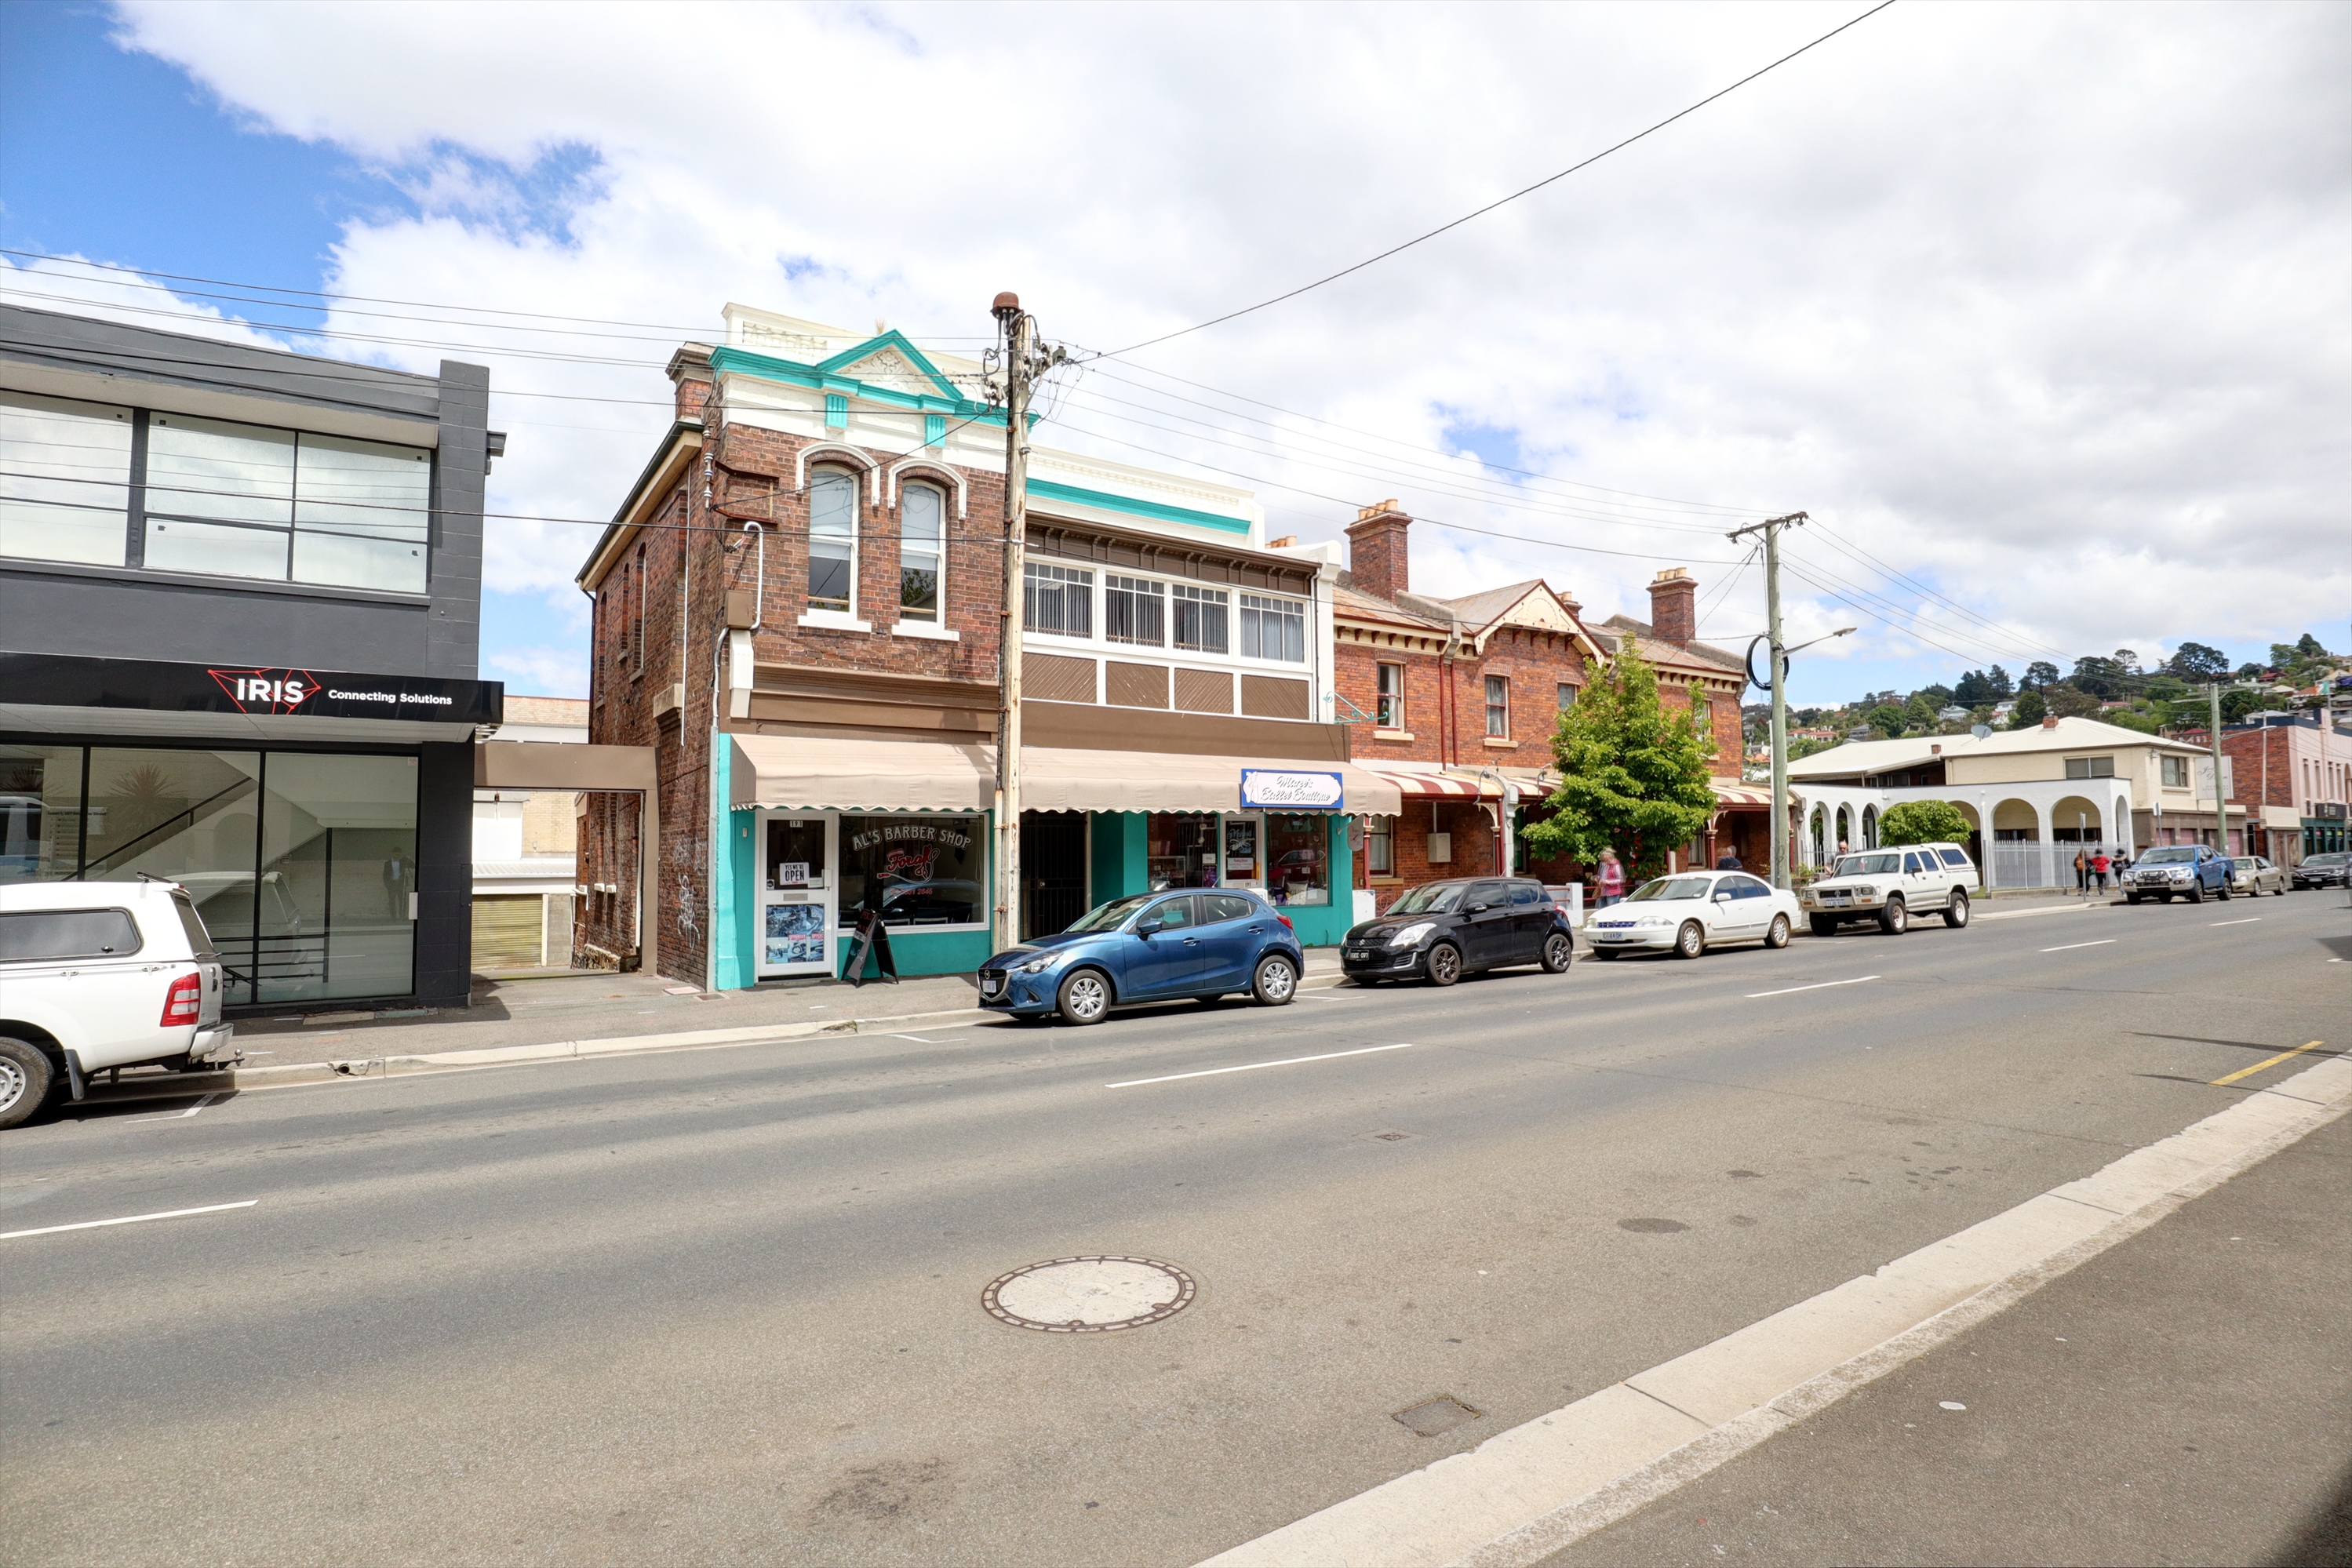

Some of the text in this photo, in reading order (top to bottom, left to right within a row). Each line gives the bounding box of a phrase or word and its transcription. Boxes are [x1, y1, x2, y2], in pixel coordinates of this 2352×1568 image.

[237, 678, 304, 703] IRIS
[328, 689, 453, 705] Connecting Solutions
[1261, 787, 1331, 802] Ballet Boutique
[851, 825, 974, 851] AL'S BARBER SHOP
[785, 869, 805, 882] OPEN
